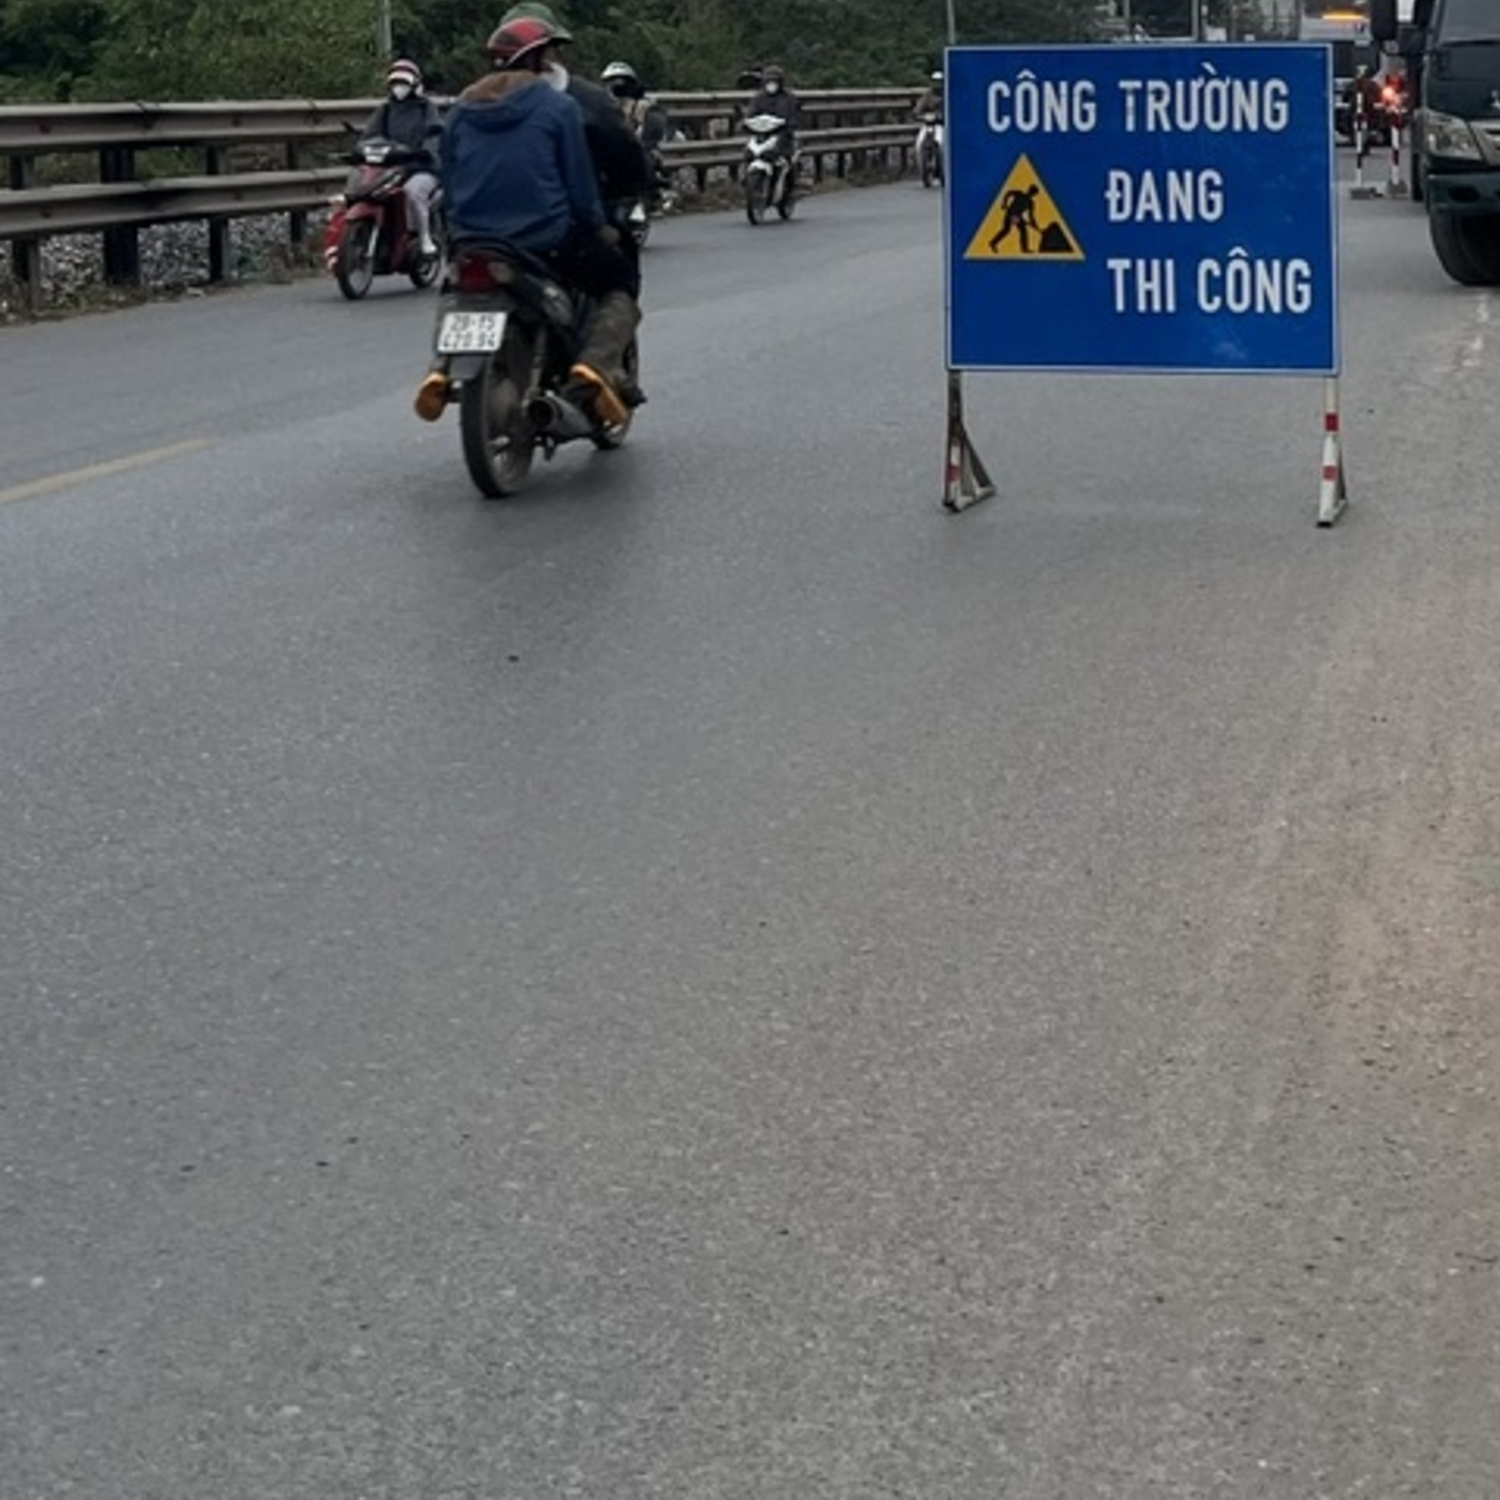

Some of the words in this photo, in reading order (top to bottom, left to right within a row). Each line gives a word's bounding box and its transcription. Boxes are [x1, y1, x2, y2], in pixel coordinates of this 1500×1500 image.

[987, 68, 1097, 132] CÔNG
[1120, 62, 1289, 132] TRƯỜNG
[1105, 169, 1224, 223] ĐANG
[1107, 258, 1176, 313] THI
[1197, 247, 1312, 313] CÔNG
